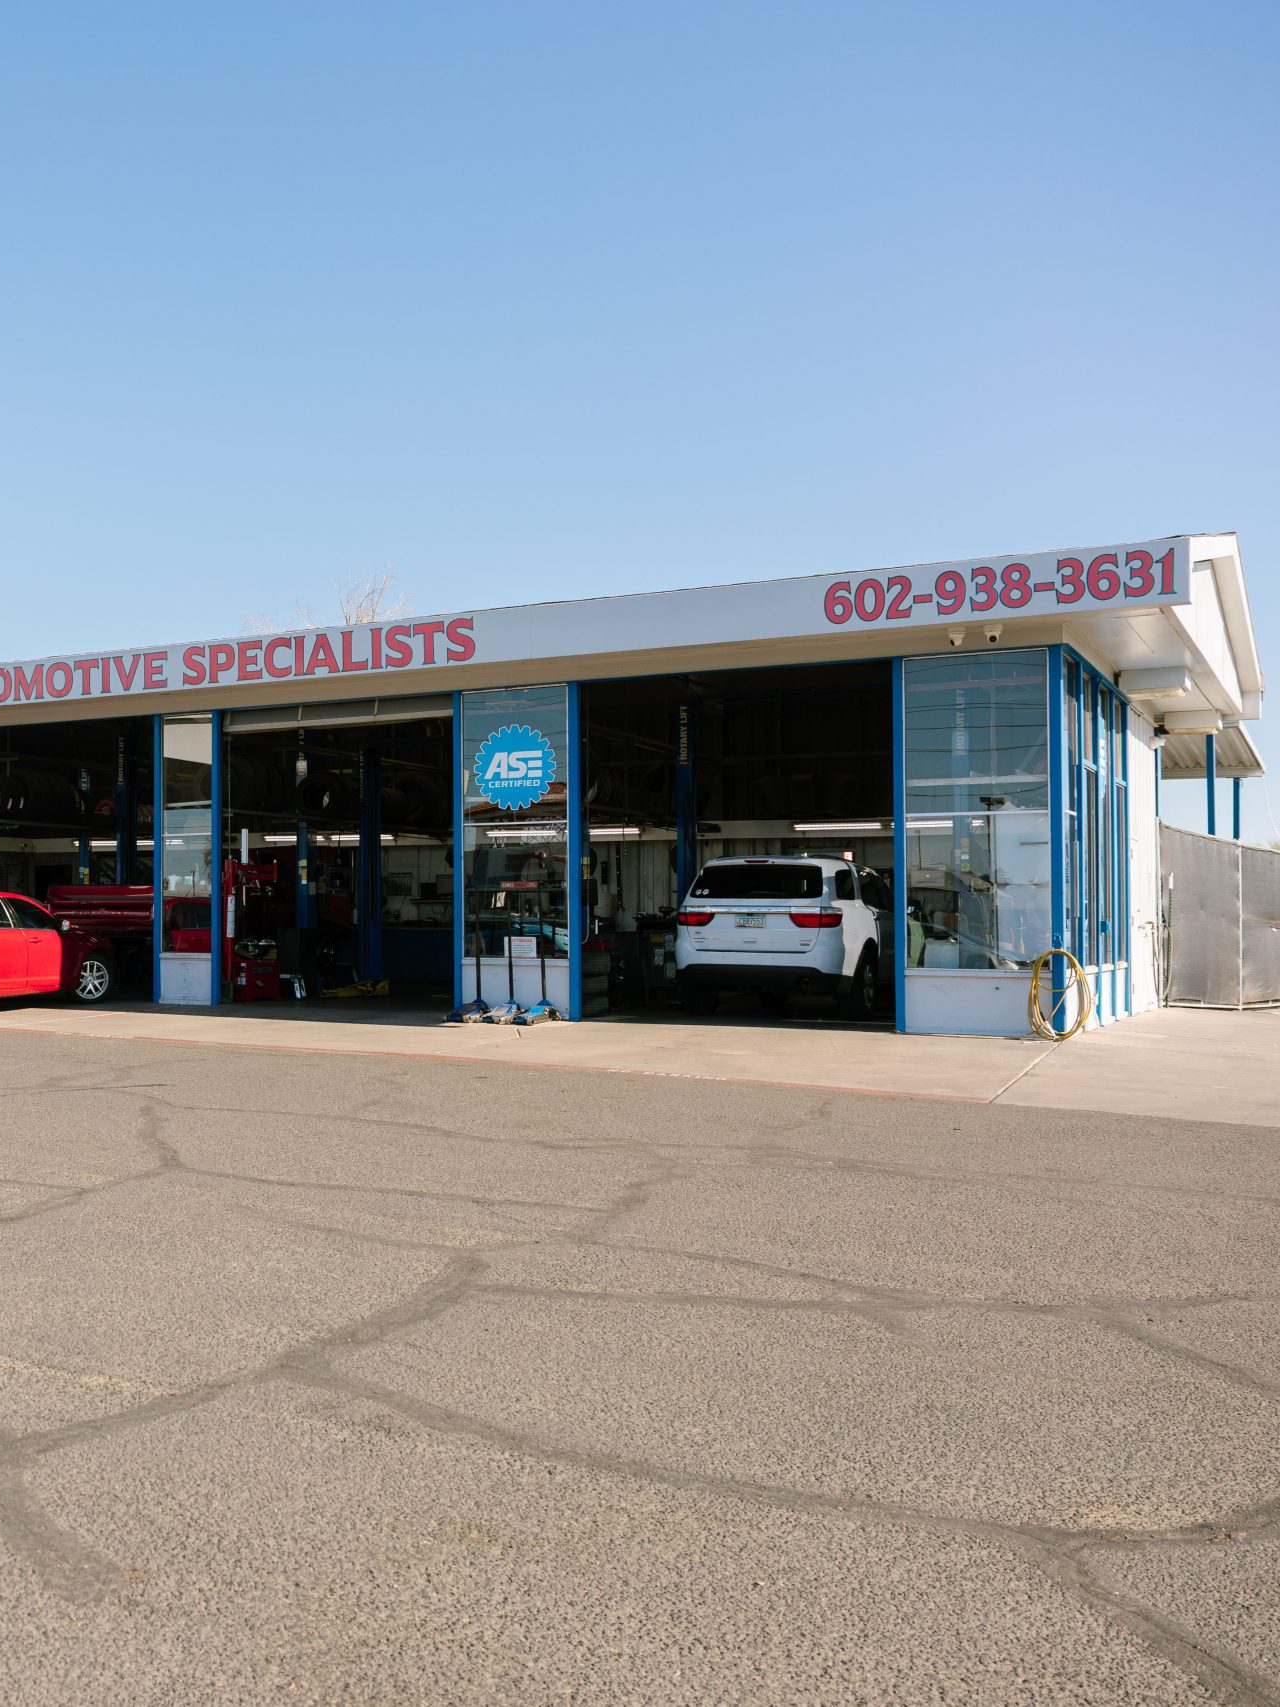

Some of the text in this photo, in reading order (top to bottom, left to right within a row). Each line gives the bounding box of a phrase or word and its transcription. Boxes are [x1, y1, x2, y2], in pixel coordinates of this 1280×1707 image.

[824, 548, 1177, 624] 602-938-3631
[182, 616, 476, 686] SPECIALISTS
[484, 750, 543, 779] ASE
[488, 779, 541, 788] CERTIFIED
